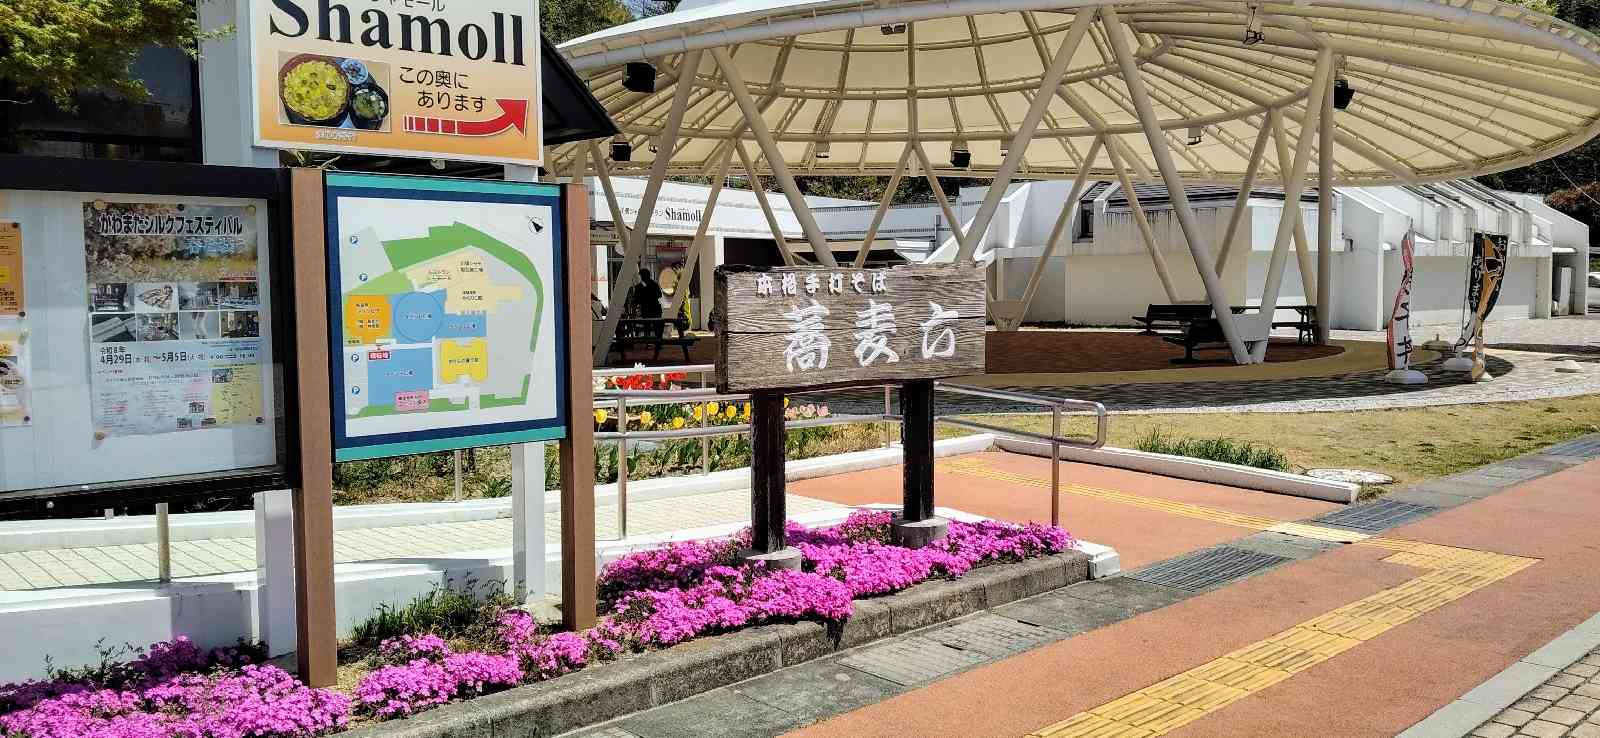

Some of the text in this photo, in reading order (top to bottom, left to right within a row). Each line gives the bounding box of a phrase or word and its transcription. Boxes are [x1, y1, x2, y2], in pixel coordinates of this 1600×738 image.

[269, 0, 526, 66] Shamoll
[399, 66, 469, 90] この奥に
[417, 91, 487, 113] あります
[101, 213, 243, 235] かわまたシルクフェスティバル
[665, 207, 702, 222] Shamoll
